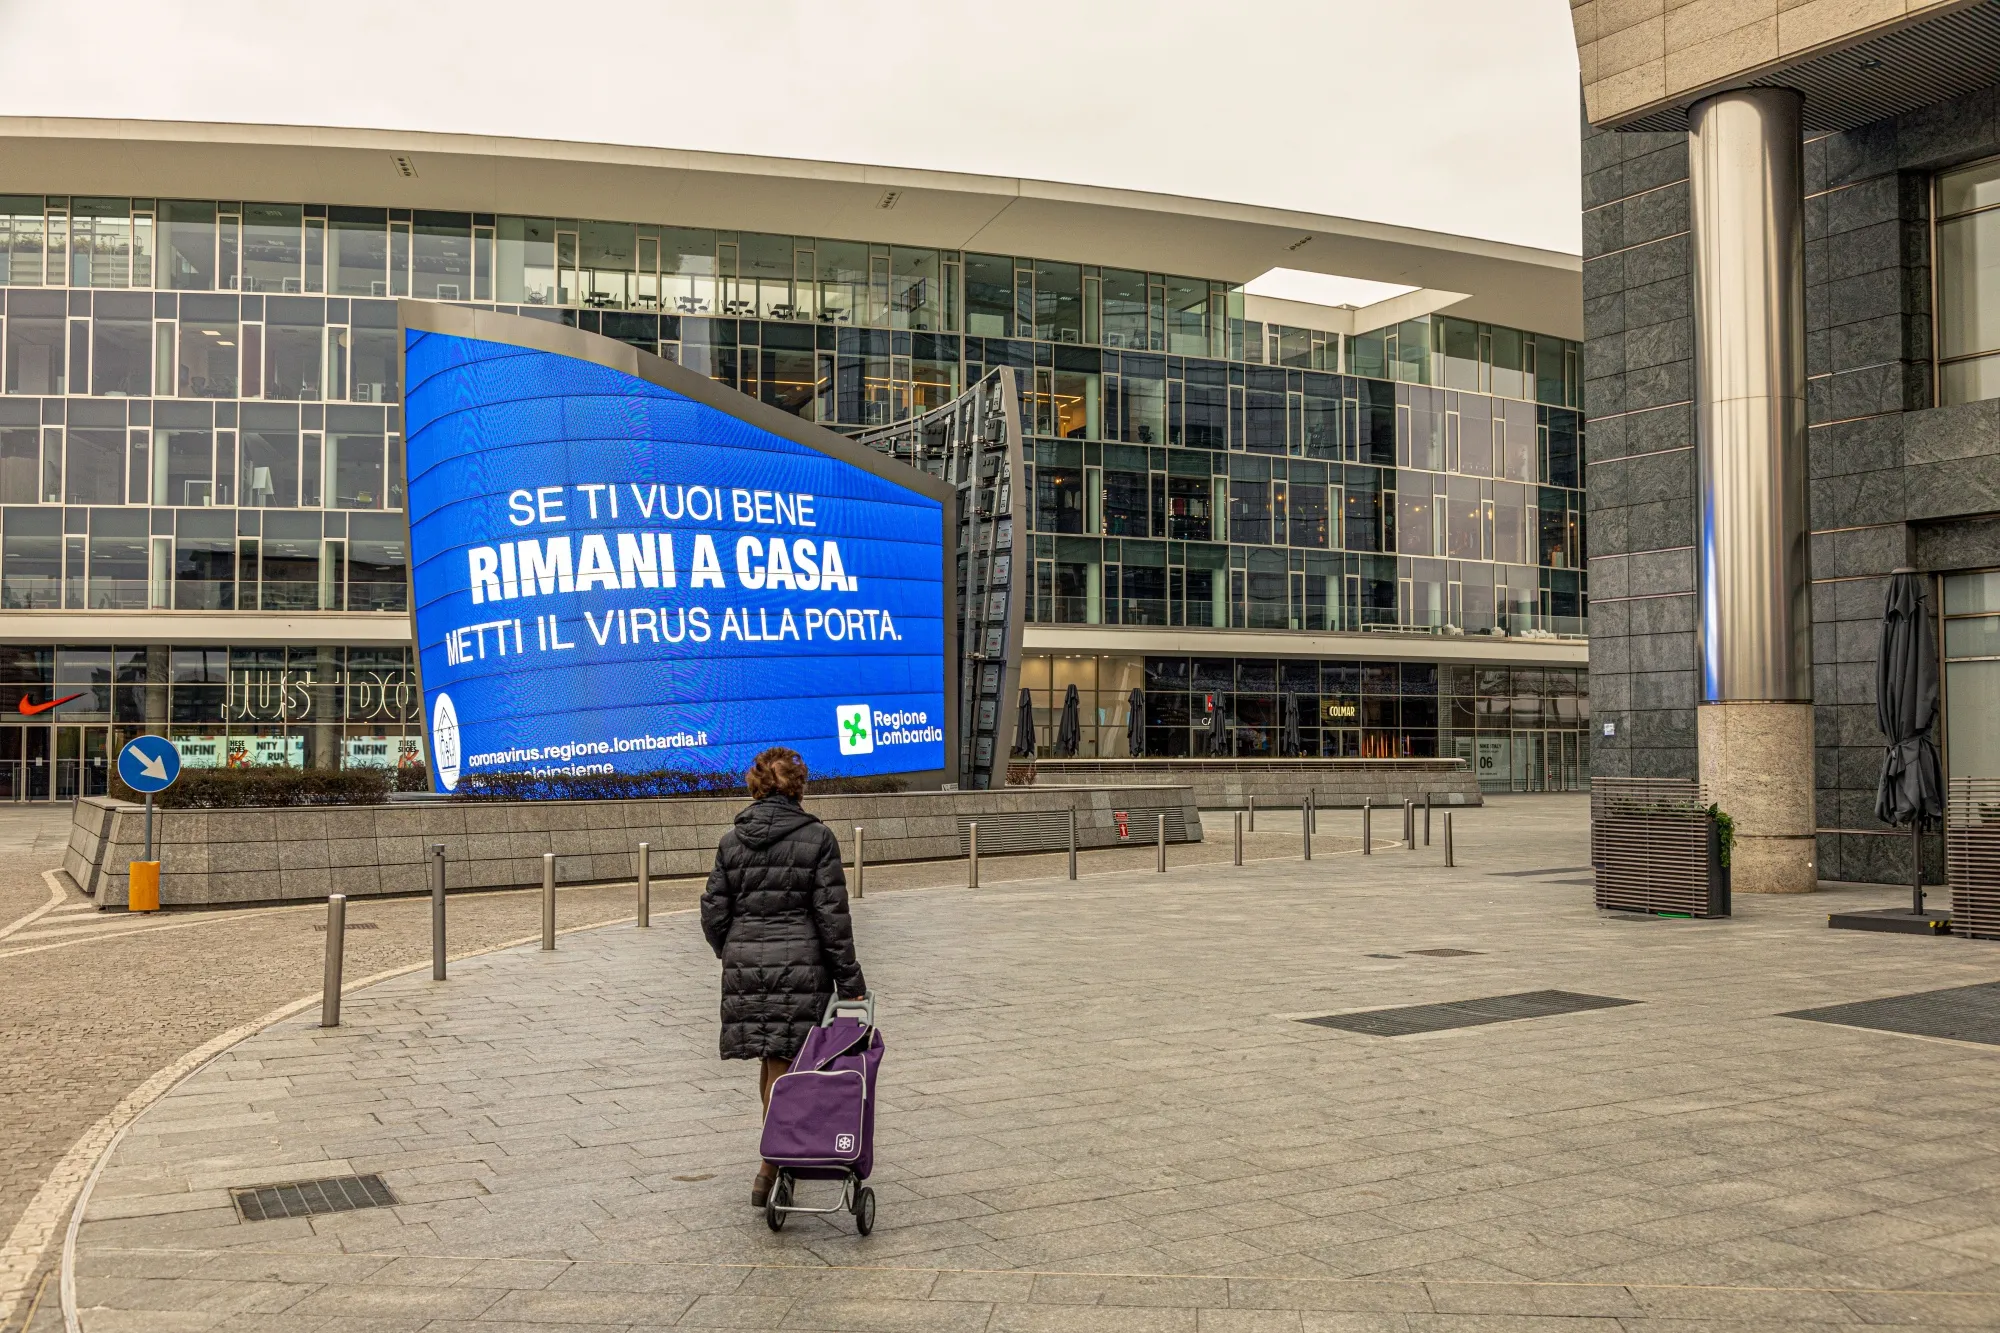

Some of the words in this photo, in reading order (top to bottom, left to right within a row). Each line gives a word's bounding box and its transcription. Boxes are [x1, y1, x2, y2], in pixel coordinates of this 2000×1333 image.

[508, 486, 567, 526] SE
[577, 484, 618, 519] TI
[631, 483, 723, 520] VUOI
[731, 487, 817, 527] BENE
[468, 532, 677, 604] RIMANI
[690, 534, 726, 589] A
[736, 535, 858, 592] CASA.
[445, 618, 523, 667] METTI
[537, 614, 575, 651] IL
[584, 606, 711, 646] VIRUS
[720, 607, 801, 641] ALLA
[804, 607, 903, 641] PORTA.
[873, 709, 928, 729] Regione
[1329, 706, 1355, 717] COLMAR
[468, 730, 708, 768] coronavirus.regione.lombardia.it
[874, 725, 943, 746] Lombardia
[1480, 756, 1493, 769] 06
